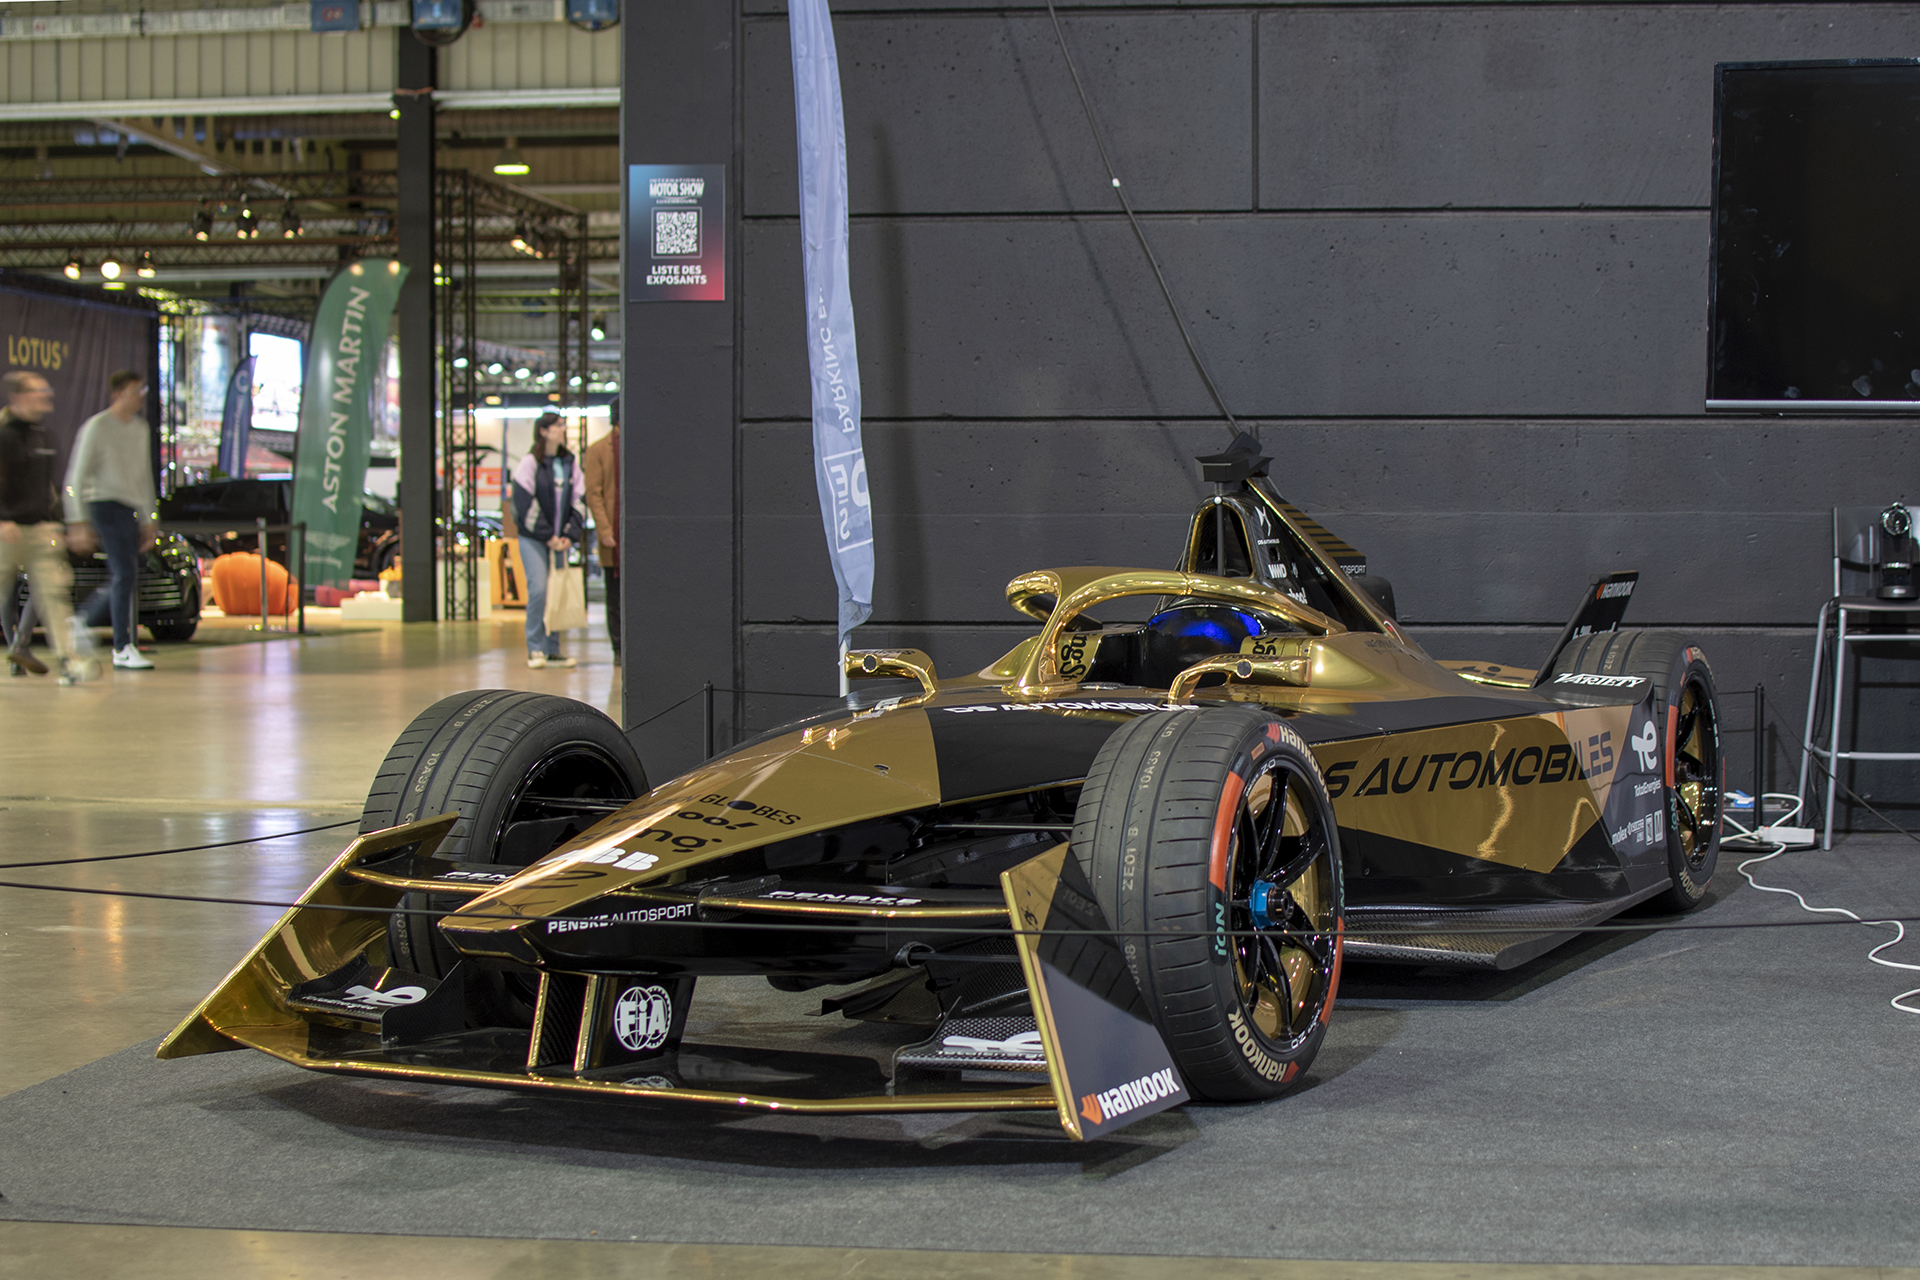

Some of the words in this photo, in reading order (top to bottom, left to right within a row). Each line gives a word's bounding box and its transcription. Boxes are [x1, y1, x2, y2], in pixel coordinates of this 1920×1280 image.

[649, 183, 679, 197] MOTOR
[680, 182, 705, 197] SHOW
[646, 275, 707, 285] EXPOSANTS
[652, 265, 680, 275] LISTE
[682, 265, 702, 275] DES
[8, 334, 62, 371] LOTUS
[332, 286, 370, 404] MARTIN
[322, 412, 349, 515] ASTON
[1324, 760, 1359, 799] S
[1352, 730, 1615, 797] AUTOMOBILES
[547, 914, 609, 934] PENSKE
[609, 903, 694, 927] AUTOSPORT
